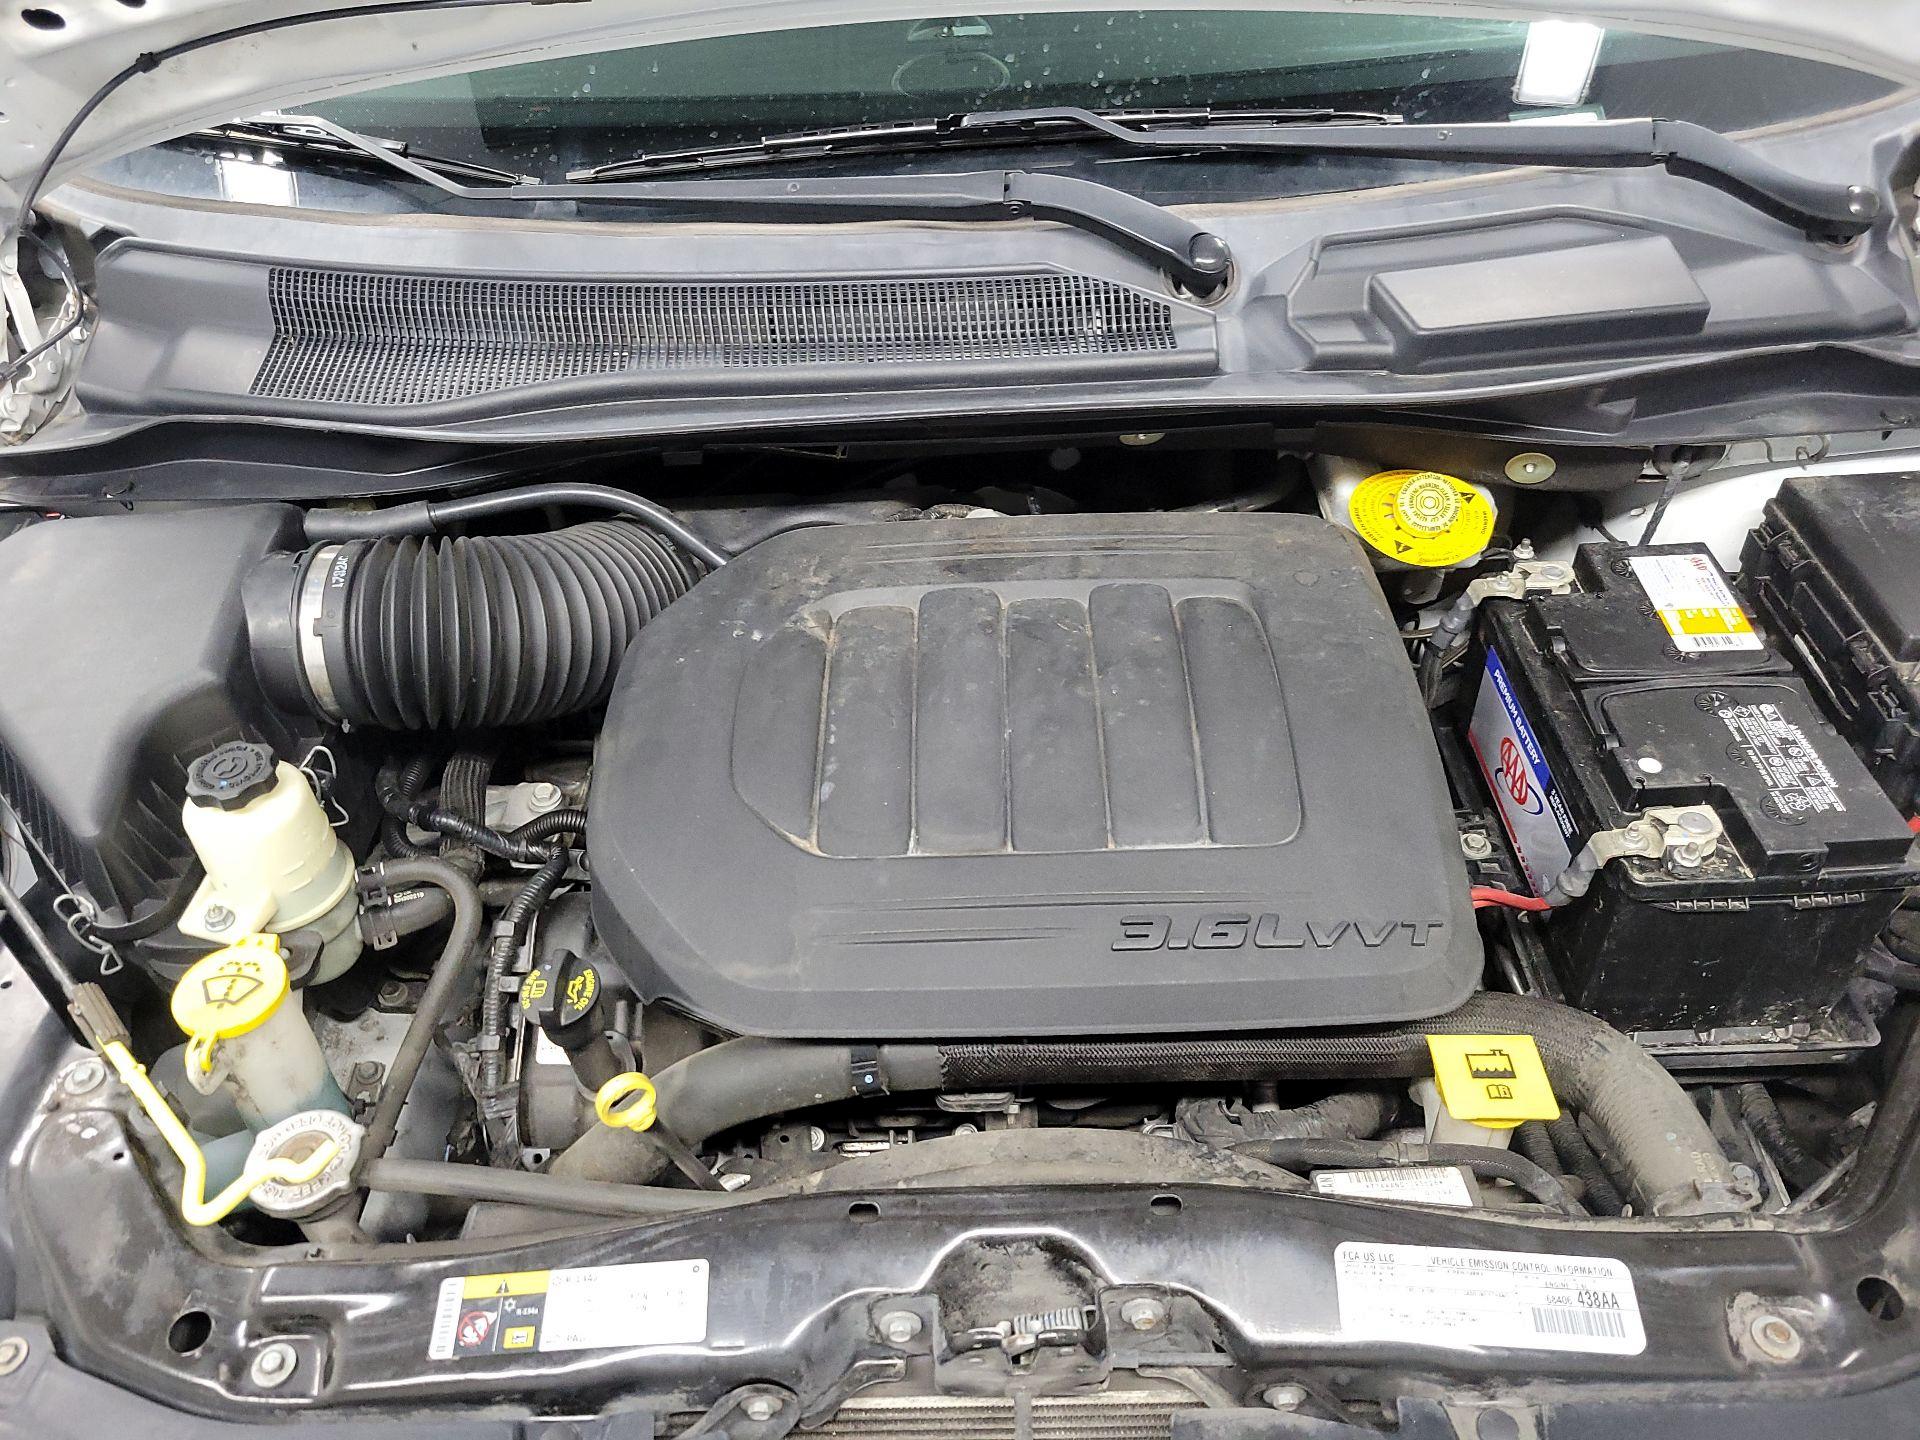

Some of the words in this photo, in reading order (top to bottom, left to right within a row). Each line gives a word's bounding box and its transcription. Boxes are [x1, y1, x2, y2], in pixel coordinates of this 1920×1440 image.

[1494, 669, 1519, 720] PREMIUM
[1515, 715, 1540, 765] BATTERY
[1363, 1252, 1376, 1262] US
[1379, 1253, 1395, 1263] LLC
[1431, 1256, 1465, 1267] VEHICLE
[1468, 1258, 1509, 1270] EMISSION
[1511, 1261, 1551, 1273] CONTROL
[1554, 1264, 1613, 1277] INFORMATION
[1577, 1290, 1620, 1309] 438AA
